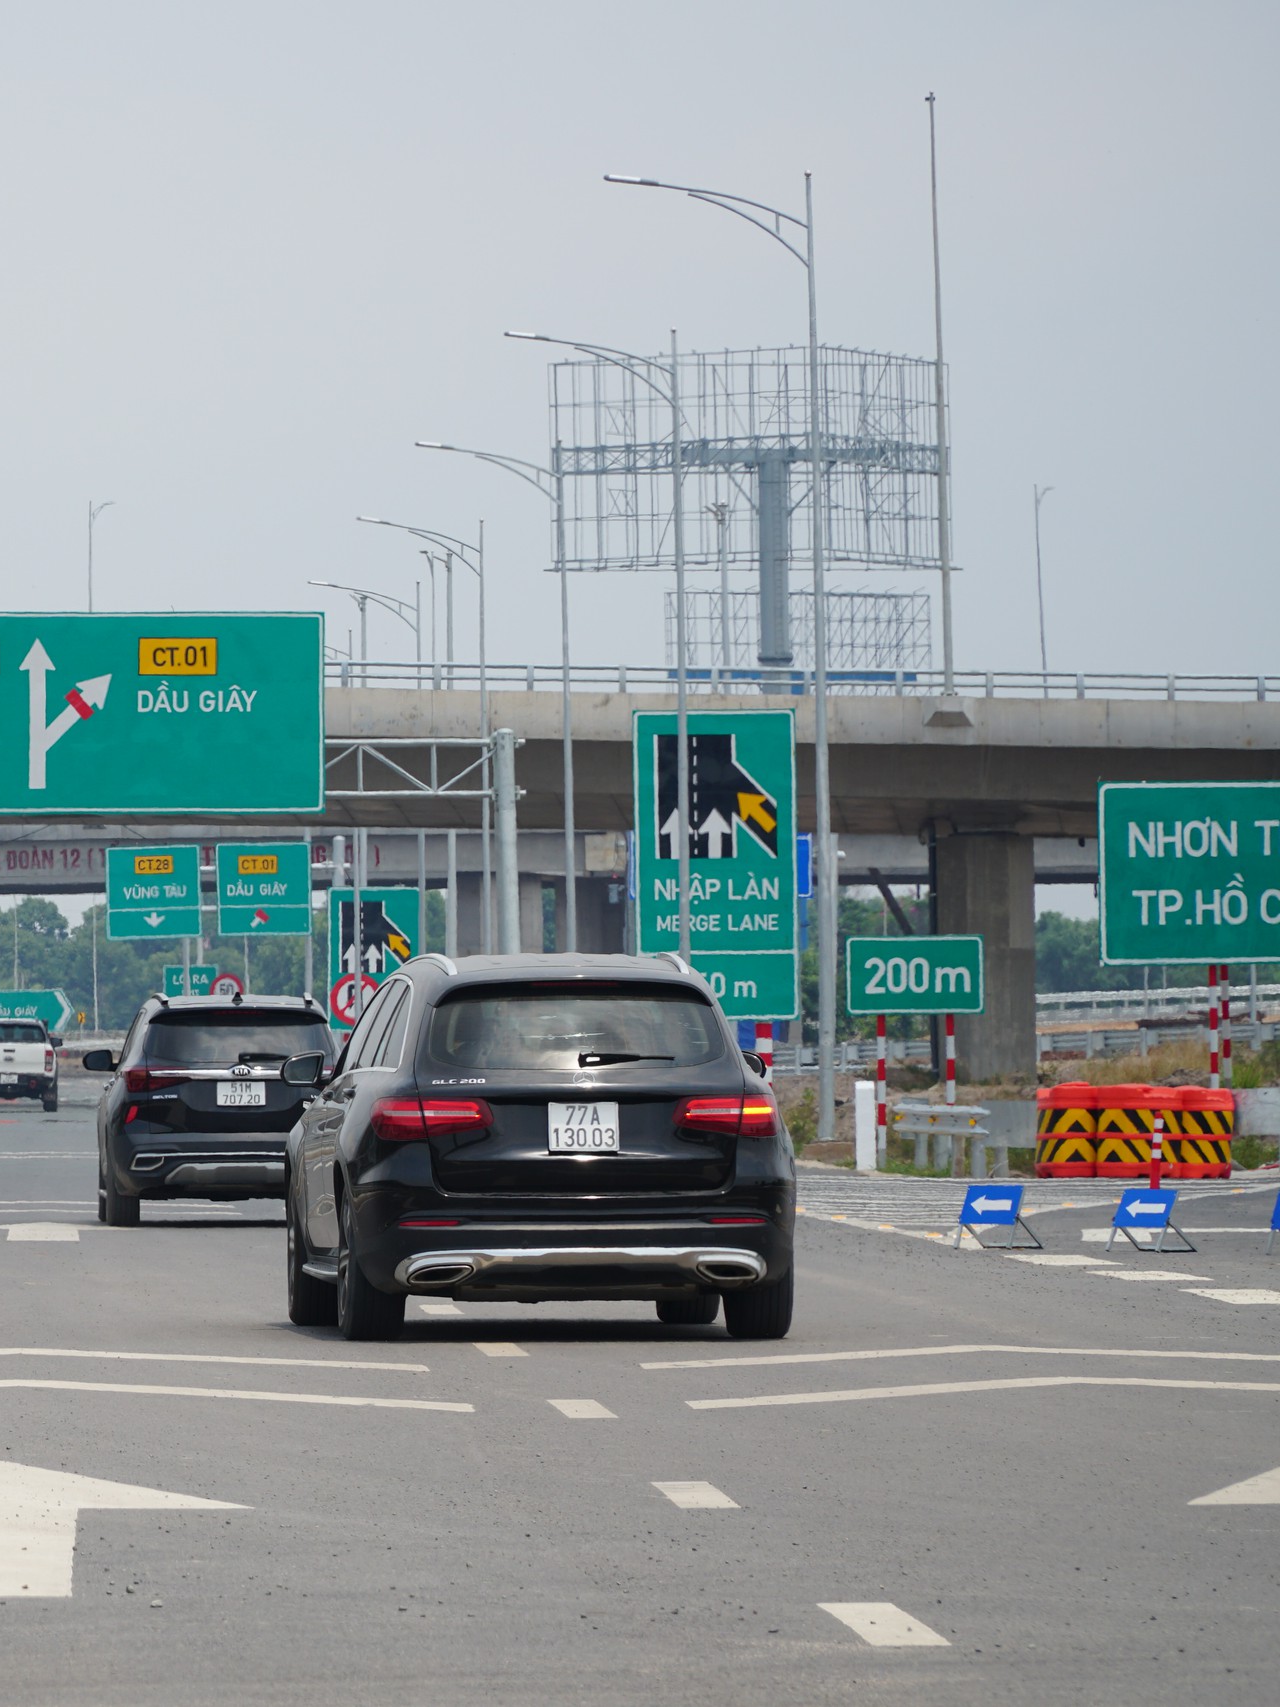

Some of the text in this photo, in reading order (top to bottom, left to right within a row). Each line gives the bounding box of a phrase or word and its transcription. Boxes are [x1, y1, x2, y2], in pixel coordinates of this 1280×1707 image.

[152, 645, 208, 668] CT.01
[137, 680, 258, 713] DẦU GIÂY
[1128, 816, 1238, 858] NHƠN
[60, 848, 81, 868] 12
[138, 859, 169, 871] CT.28
[241, 859, 275, 870] CT.01
[123, 884, 160, 900] VŨNG
[654, 871, 779, 905] NHẬP LÀN
[1132, 873, 1248, 925] TP.HỒ
[656, 914, 779, 932] MERGE LANE
[192, 974, 209, 984] RA
[733, 979, 757, 998] m
[230, 1083, 252, 1093] 51M
[222, 1094, 261, 1104] 707.20
[566, 1105, 600, 1126] 77A
[553, 1128, 616, 1148] 130.03
